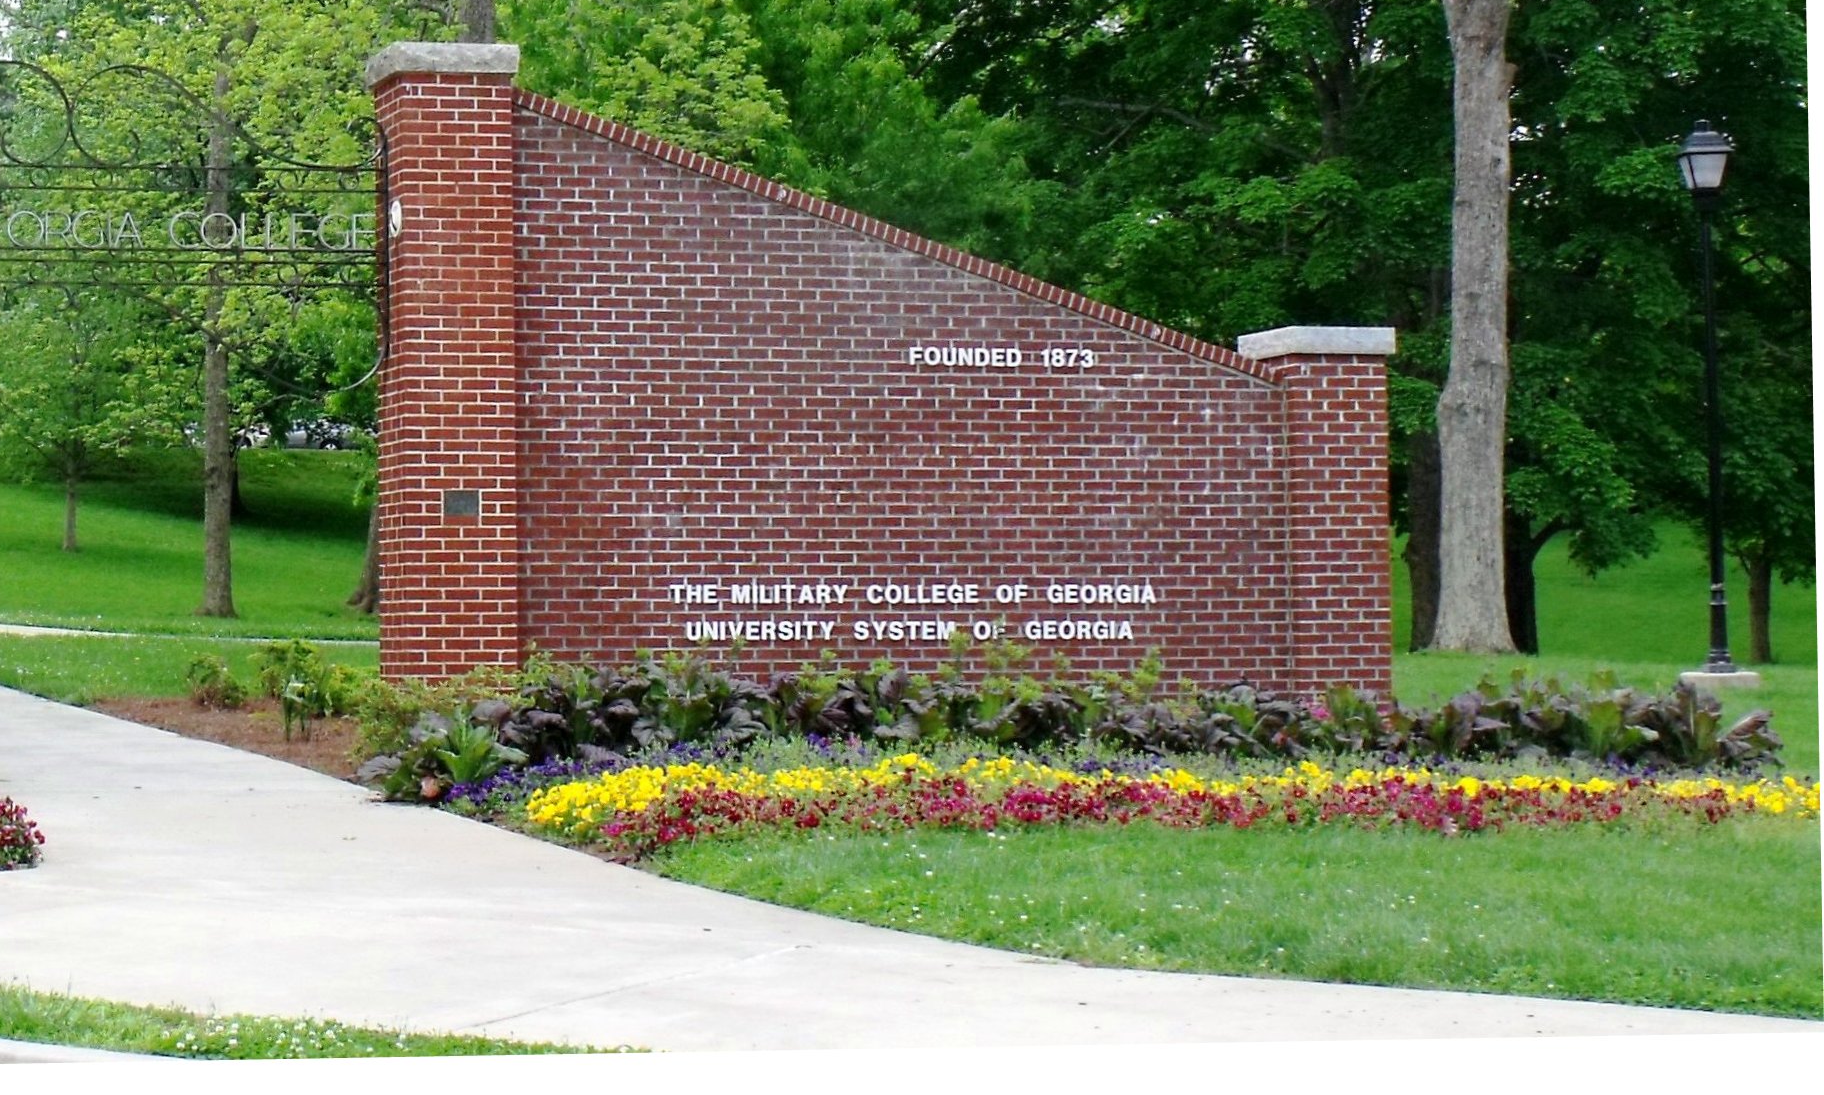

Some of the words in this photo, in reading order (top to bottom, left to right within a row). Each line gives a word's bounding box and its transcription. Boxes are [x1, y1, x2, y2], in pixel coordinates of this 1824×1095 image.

[169, 211, 376, 251] COLLEGE
[909, 346, 1022, 368] FOUNDED
[1040, 348, 1095, 368] 1873
[670, 584, 718, 604] THE
[731, 584, 848, 604] MILITARY
[866, 584, 979, 604] COLLEGE
[996, 584, 1028, 604] OF
[1047, 584, 1156, 604] GEORGIA
[686, 621, 835, 641] UNIVERSITY
[853, 621, 955, 641] SYSTEM
[1025, 620, 1133, 640] GEORGIA
